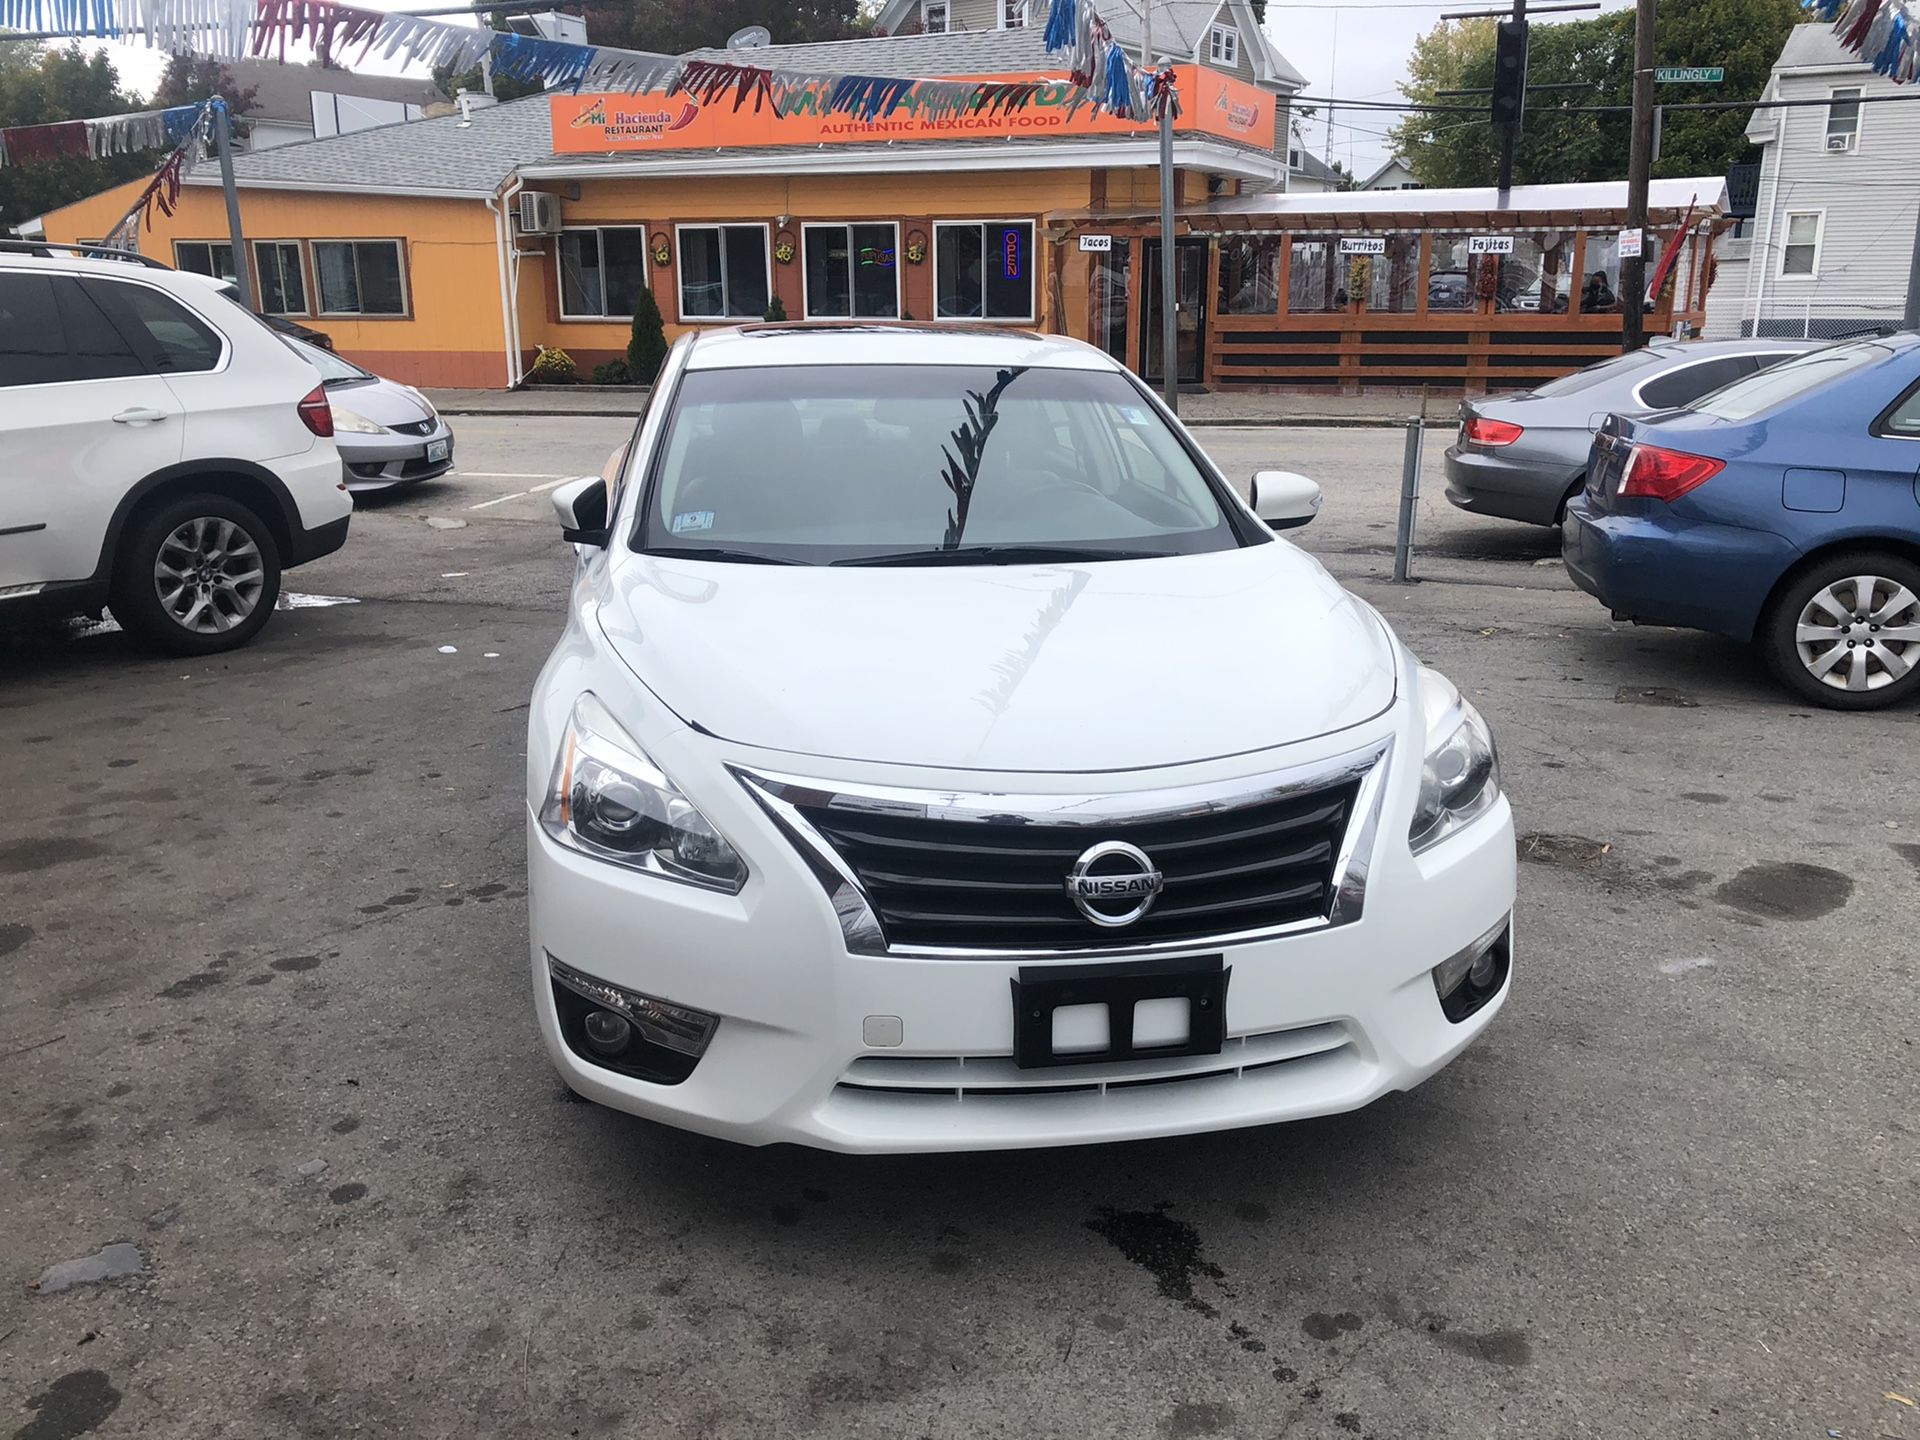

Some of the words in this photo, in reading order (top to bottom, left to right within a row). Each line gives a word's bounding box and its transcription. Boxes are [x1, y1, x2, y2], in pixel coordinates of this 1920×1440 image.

[1657, 69, 1712, 80] KILLINGLY
[591, 112, 606, 125] Mi
[615, 111, 671, 124] Hacienda
[820, 121, 914, 134] AUTHENTIC
[920, 118, 1002, 130] MEXICAN
[1008, 116, 1061, 127] FOOD
[604, 124, 664, 135] RESTAURANT
[1082, 236, 1109, 248] Tacos
[1341, 240, 1384, 251] Burritos
[1472, 238, 1510, 253] Fajitas
[1006, 232, 1017, 276] OPEN
[1077, 878, 1155, 894] NISSAN
